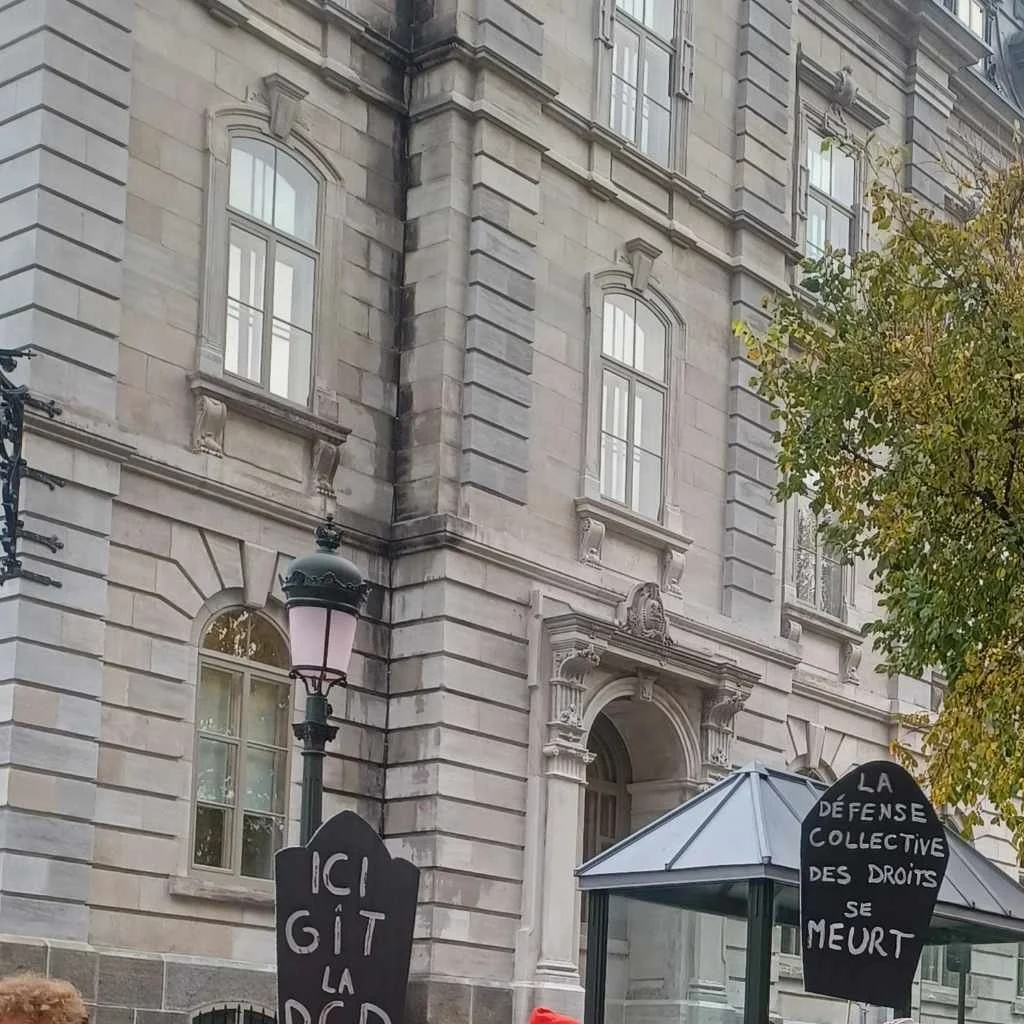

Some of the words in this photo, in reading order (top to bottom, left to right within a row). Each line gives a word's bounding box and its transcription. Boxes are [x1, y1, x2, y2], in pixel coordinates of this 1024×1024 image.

[858, 772, 893, 793] LA
[818, 793, 928, 824] DÉFENSE
[312, 851, 369, 897] ICI
[809, 866, 851, 885] DES
[844, 900, 872, 918] SE
[285, 903, 386, 956] GÎT
[807, 919, 915, 959] MEURT
[321, 966, 354, 994] LA
